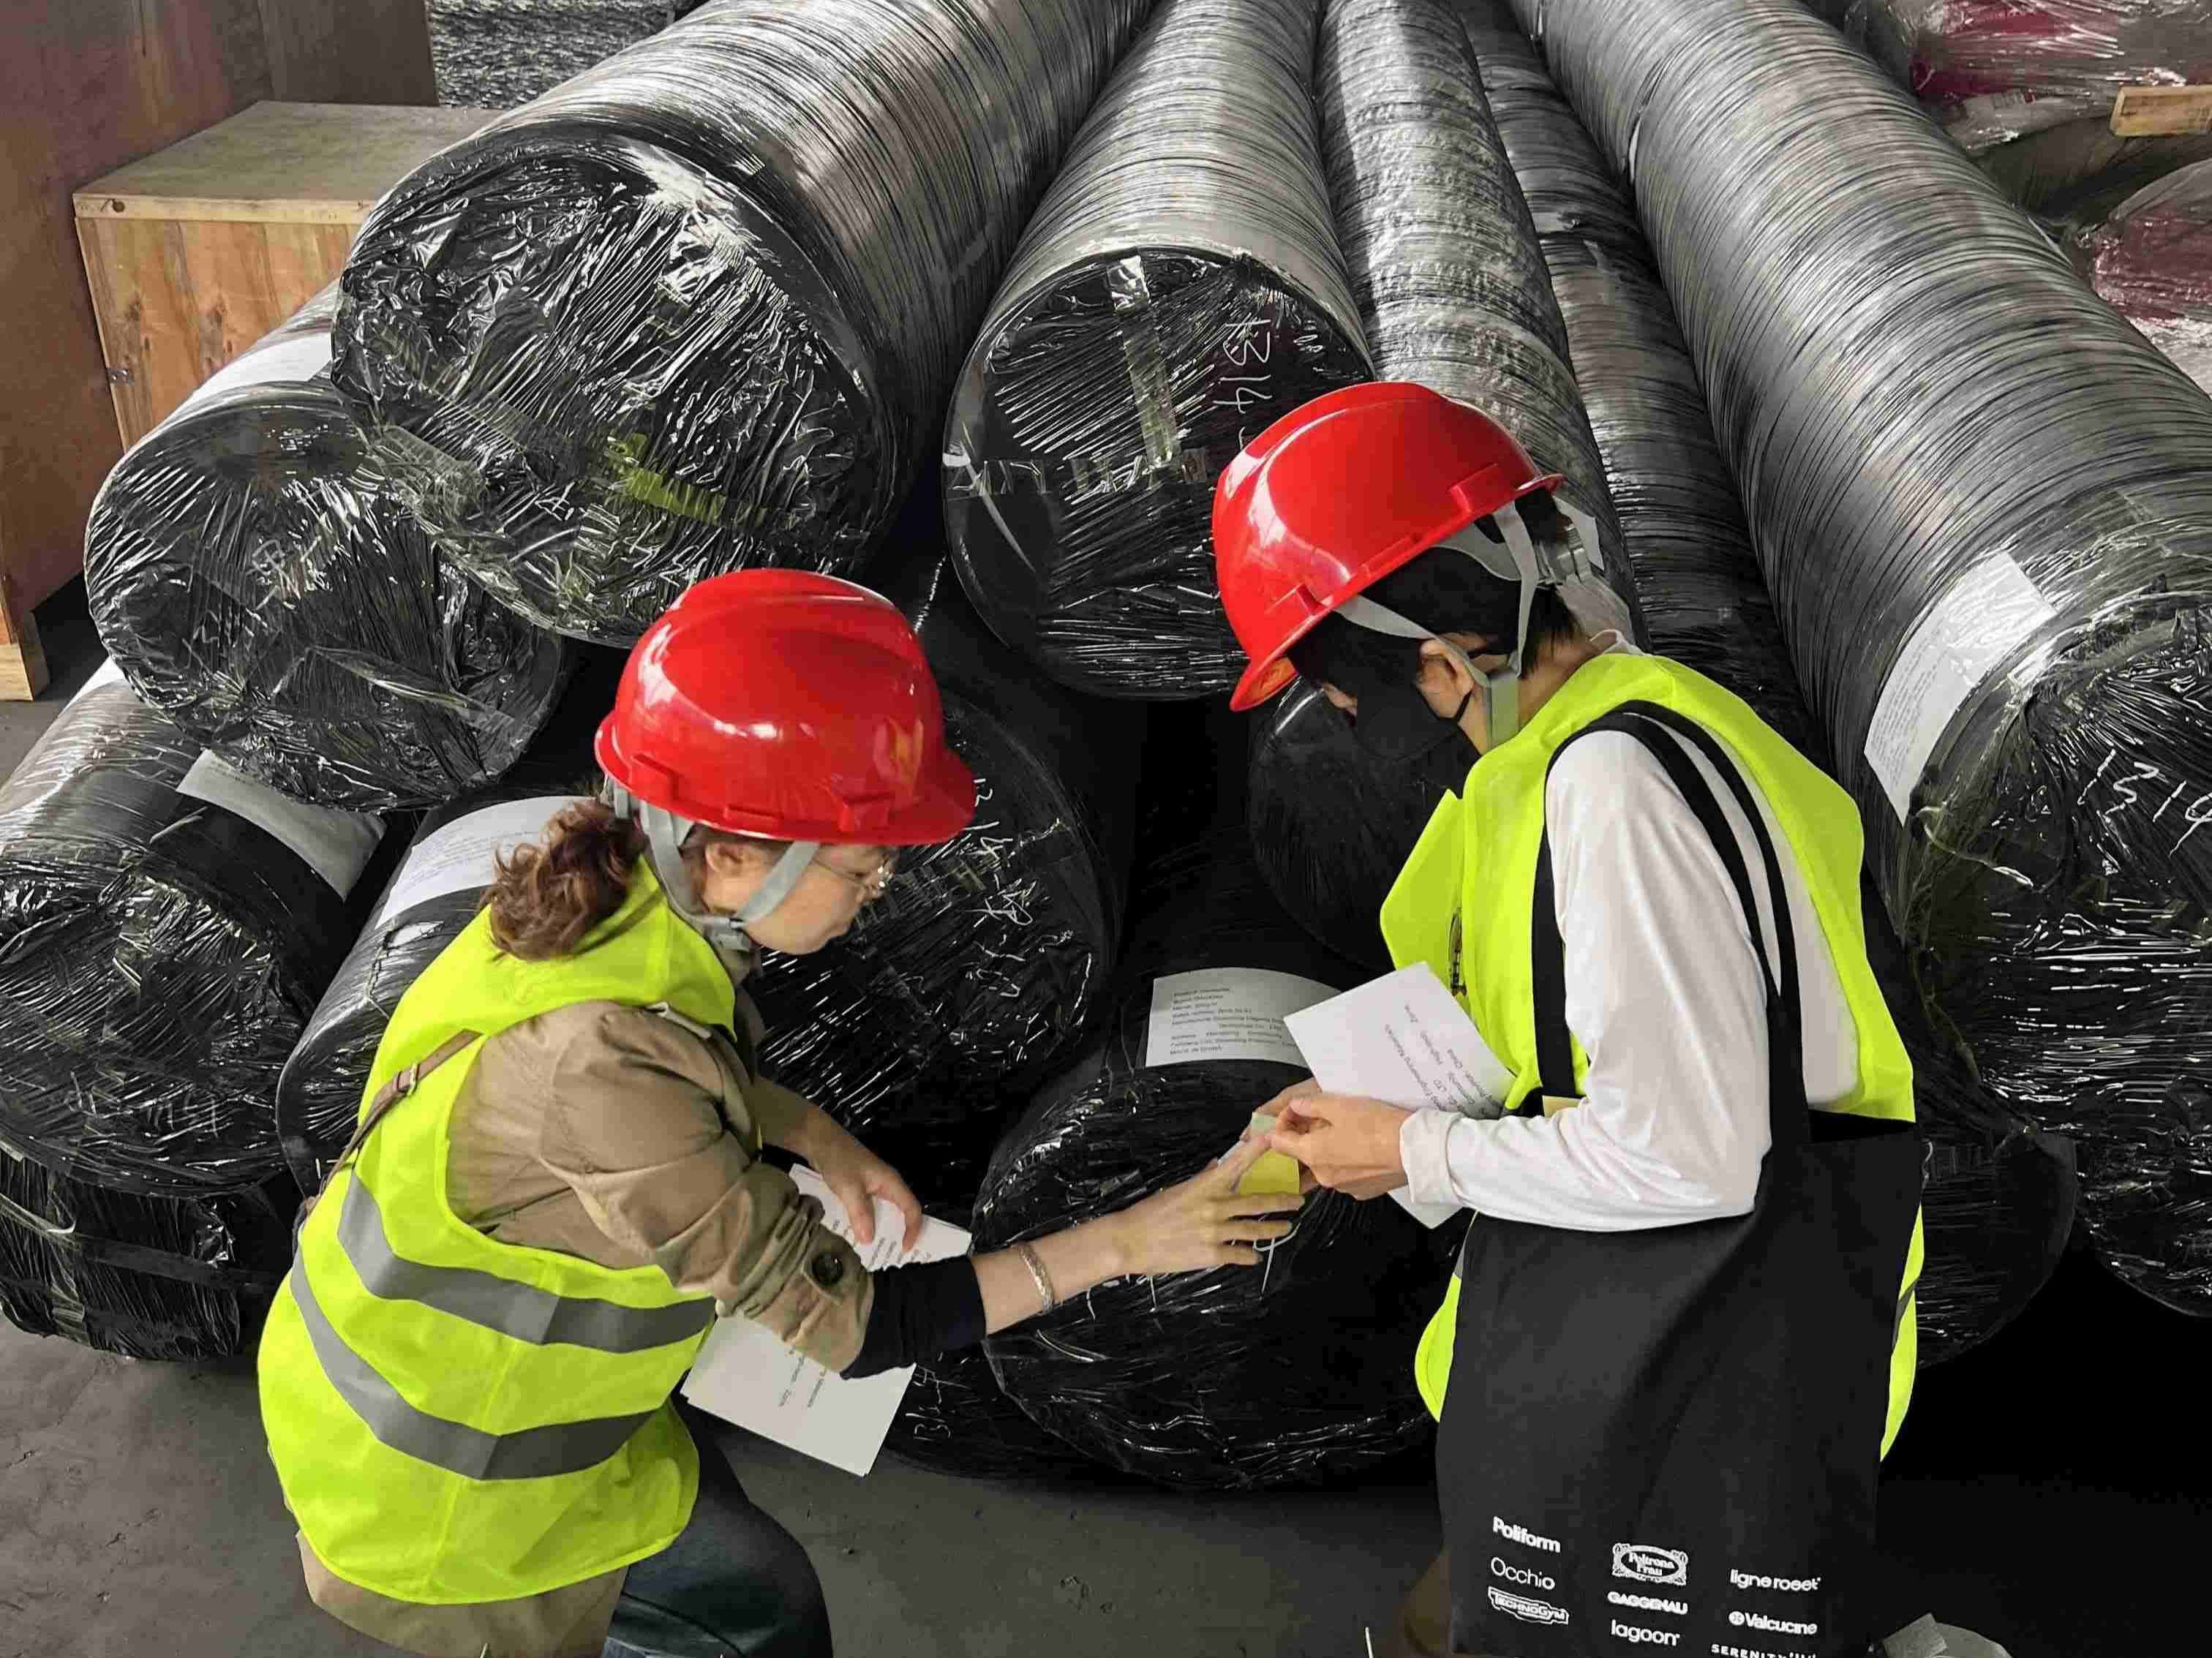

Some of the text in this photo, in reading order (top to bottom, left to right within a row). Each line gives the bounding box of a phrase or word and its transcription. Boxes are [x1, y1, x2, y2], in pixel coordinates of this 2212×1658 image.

[1492, 1515, 1561, 1553] Poliform
[1490, 1556, 1556, 1590] Occhio
[1730, 1568, 1772, 1589] ligne
[1607, 1591, 1689, 1616] GAGGENAU
[1611, 1619, 1679, 1646] lagoon
[1744, 1612, 1818, 1635] Valcucine
